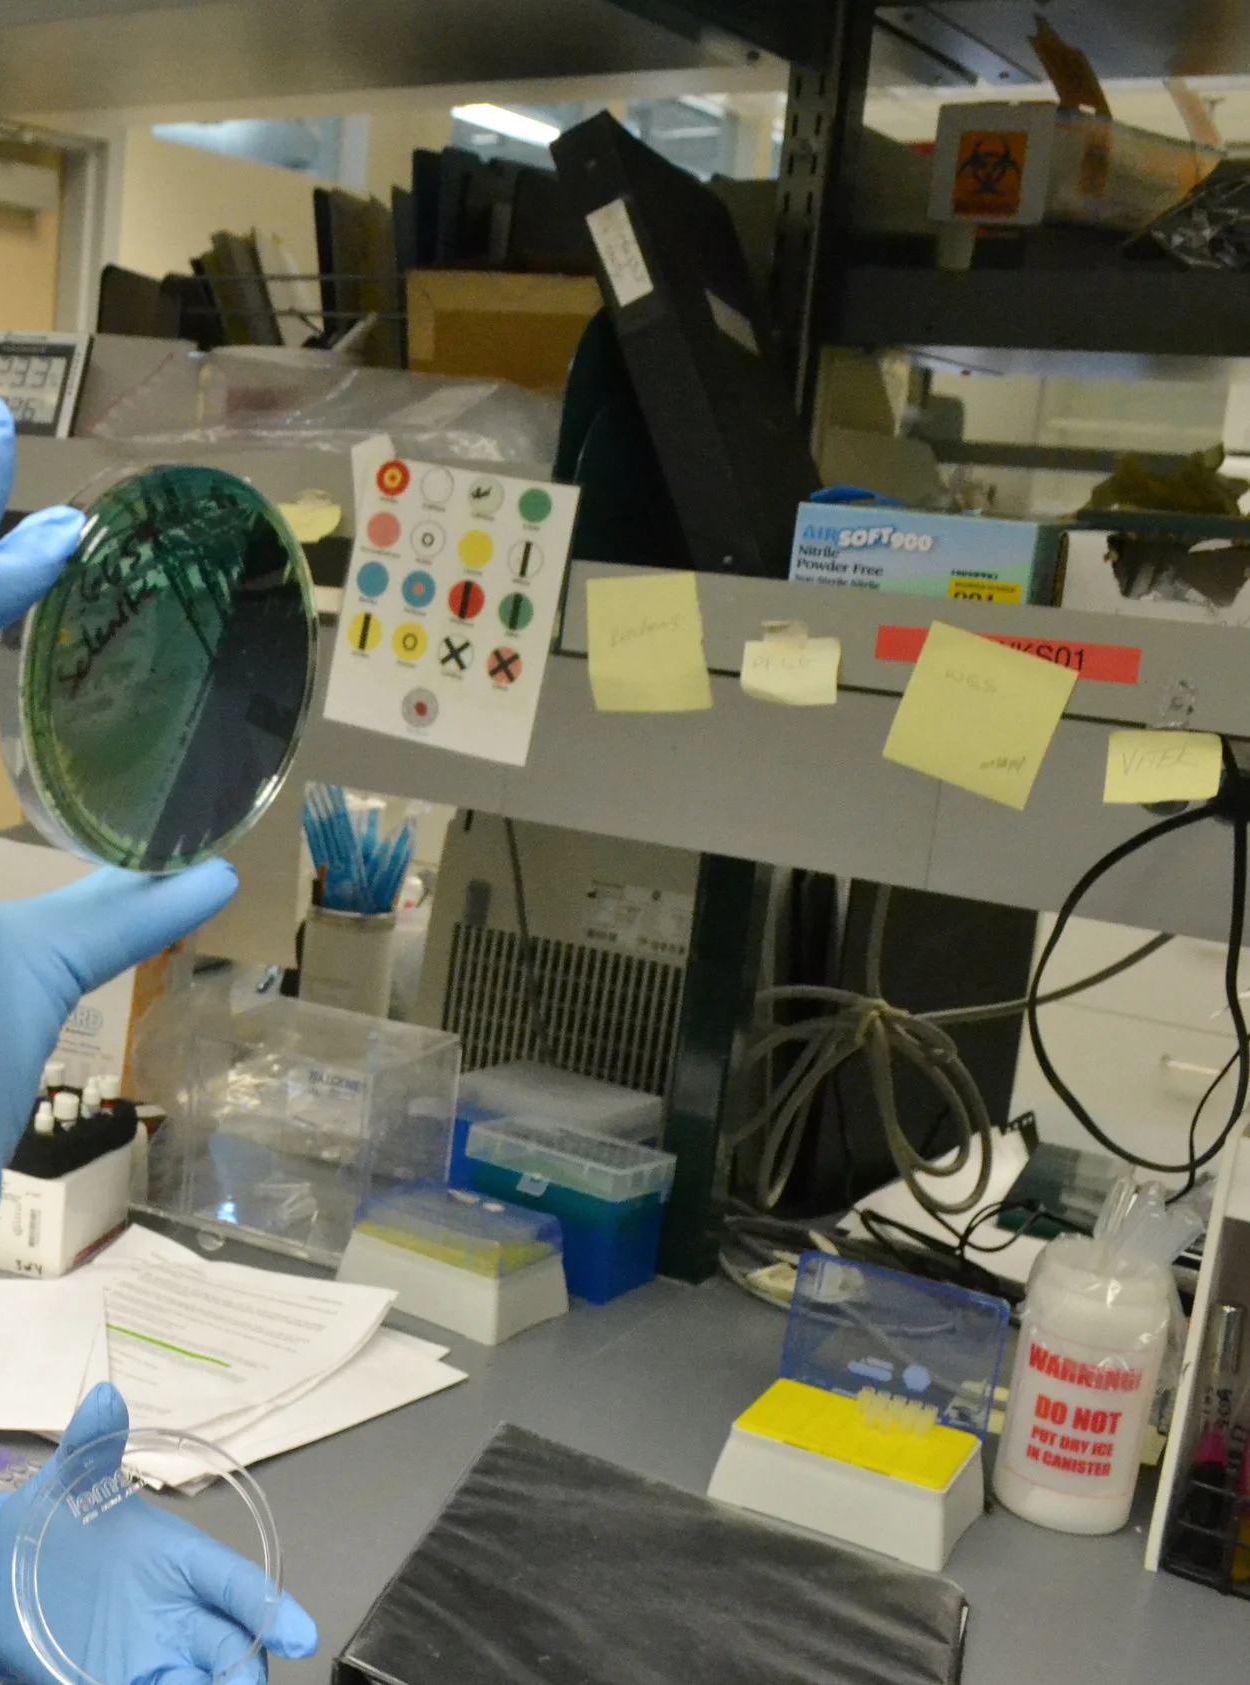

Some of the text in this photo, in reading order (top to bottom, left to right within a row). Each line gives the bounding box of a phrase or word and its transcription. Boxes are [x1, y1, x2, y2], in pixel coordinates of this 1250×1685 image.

[799, 545, 840, 559] Nitrile
[797, 559, 884, 577] Powder Free
[1034, 1394, 1123, 1435] DO NOT
[1031, 1426, 1114, 1457] PUT DRY ICE
[1026, 1444, 1112, 1476] IN CANISTER
